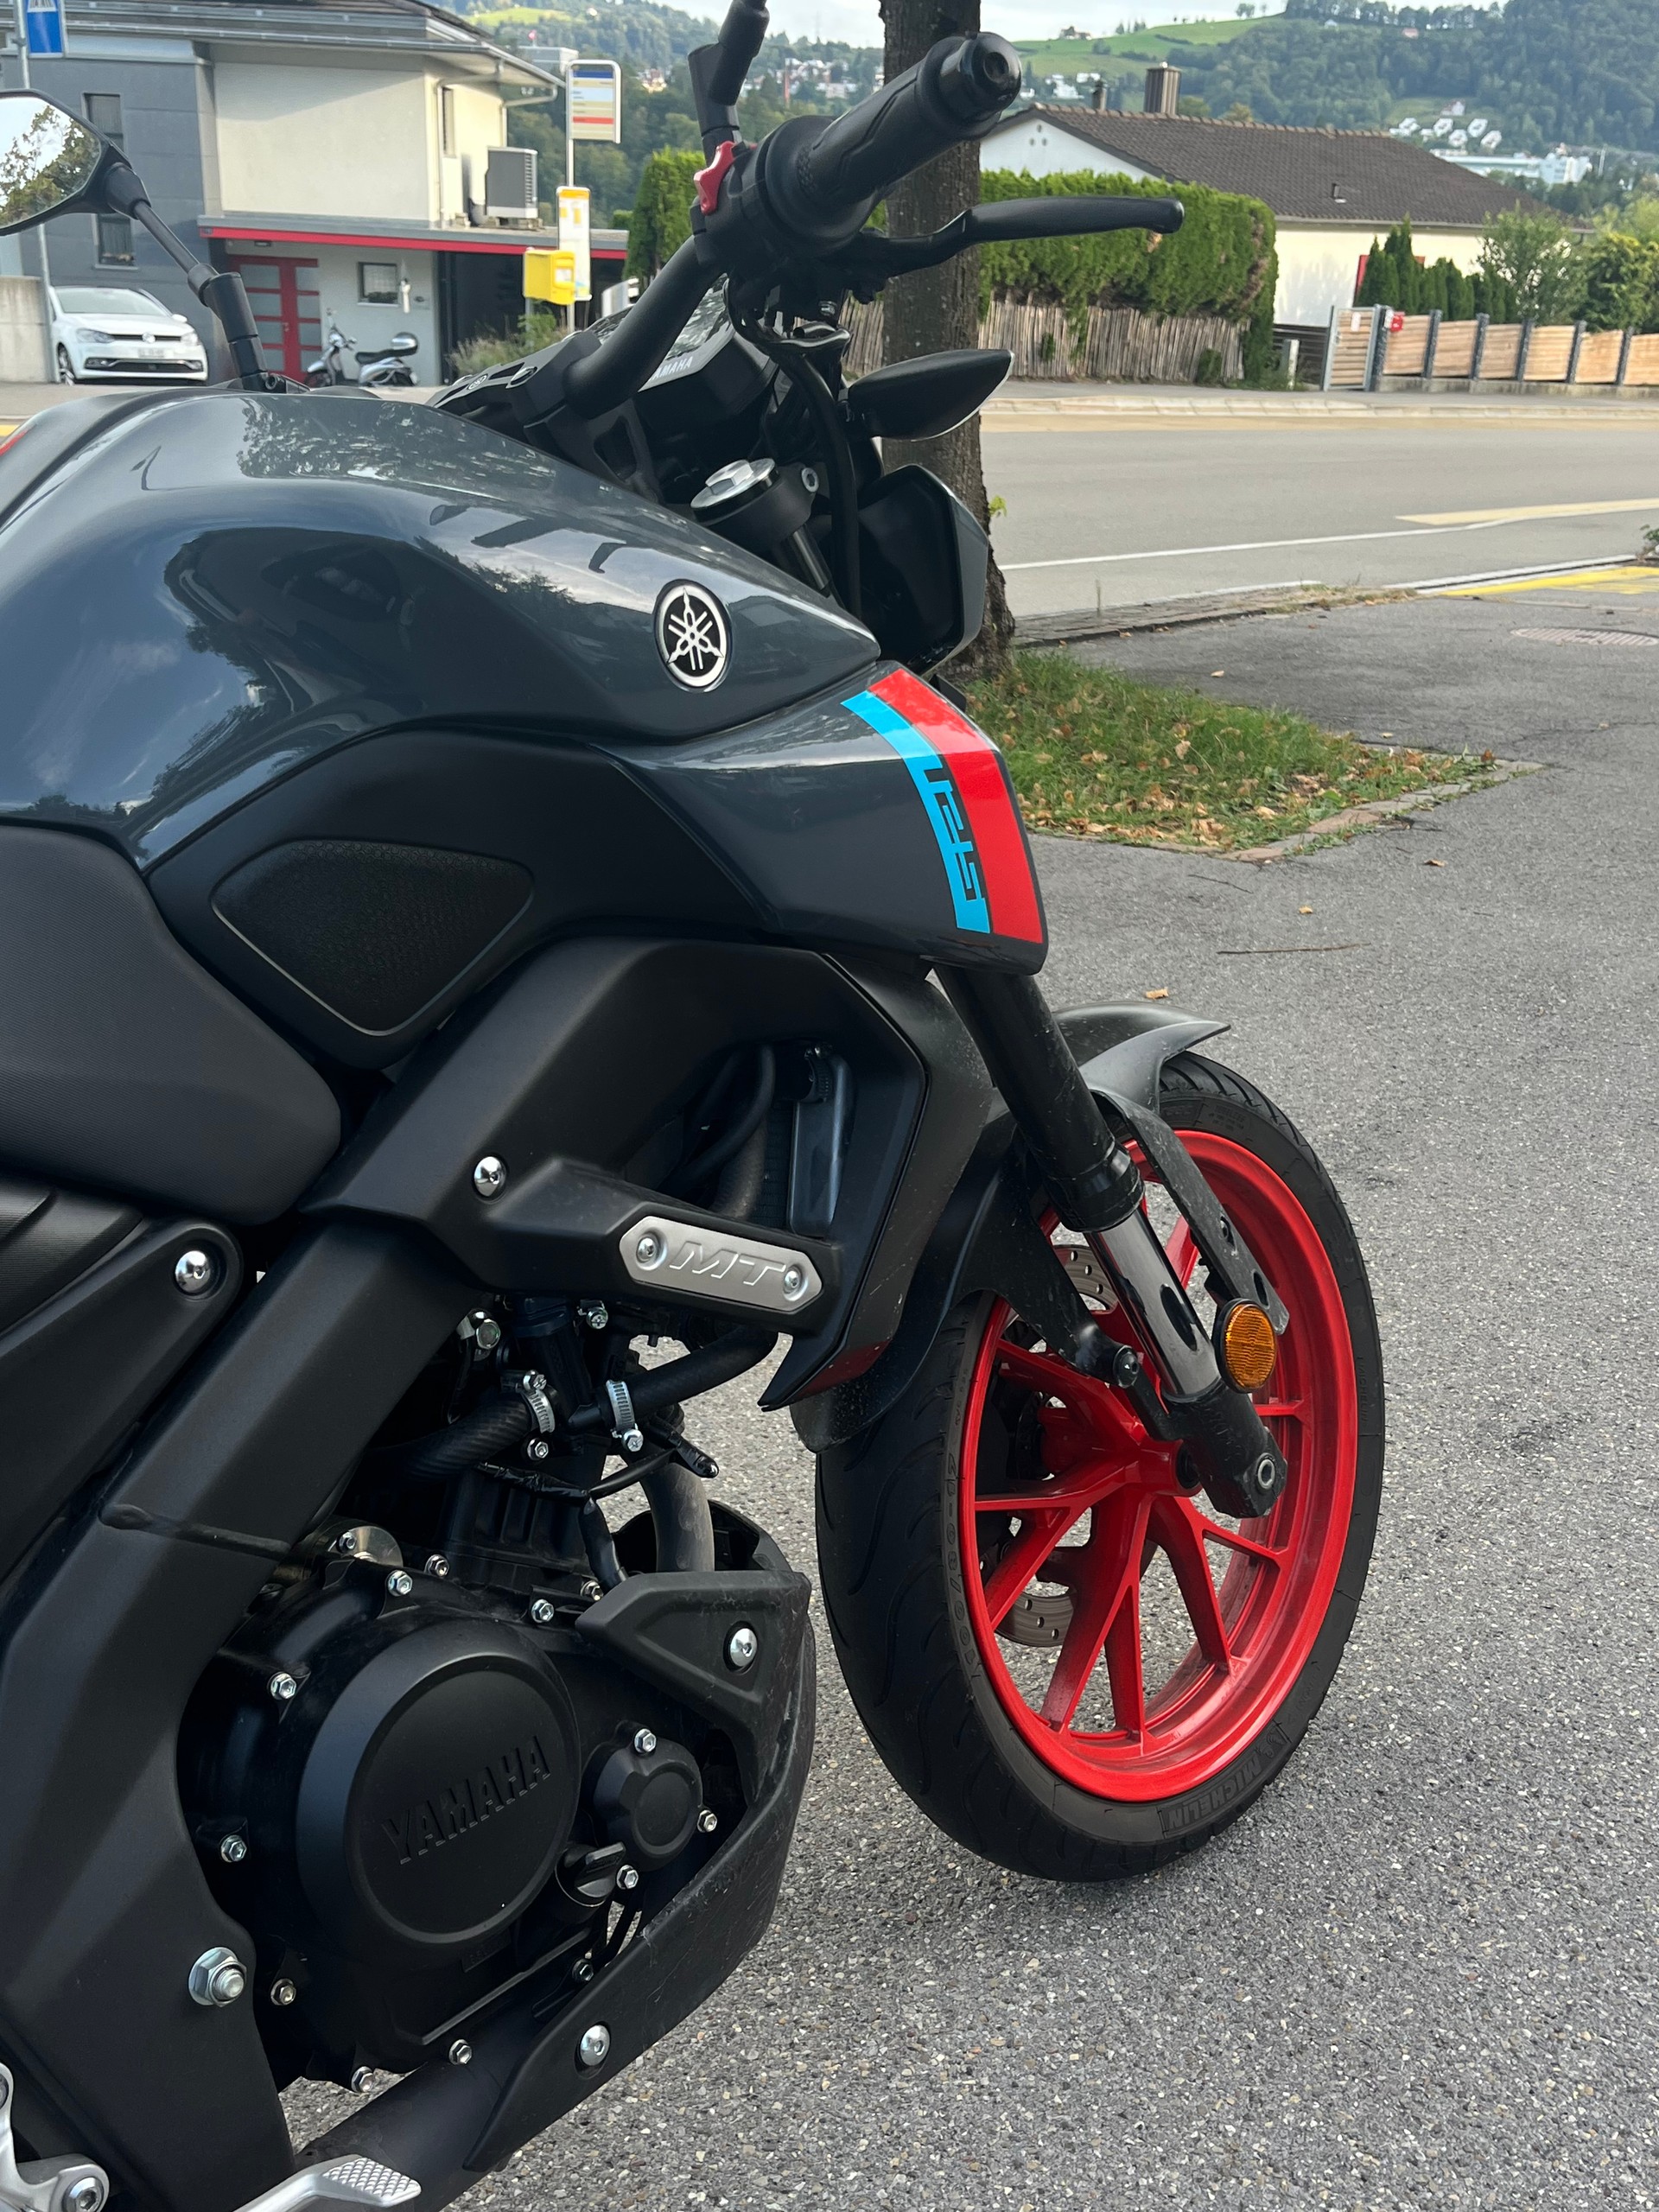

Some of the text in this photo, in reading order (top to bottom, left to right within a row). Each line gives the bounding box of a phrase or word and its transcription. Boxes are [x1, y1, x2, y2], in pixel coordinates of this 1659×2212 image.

[650, 356, 693, 380] AMAHA
[669, 1241, 786, 1286] MT
[381, 1735, 550, 1865] YAMAHA
[1168, 1757, 1262, 1828] MICHELIN
